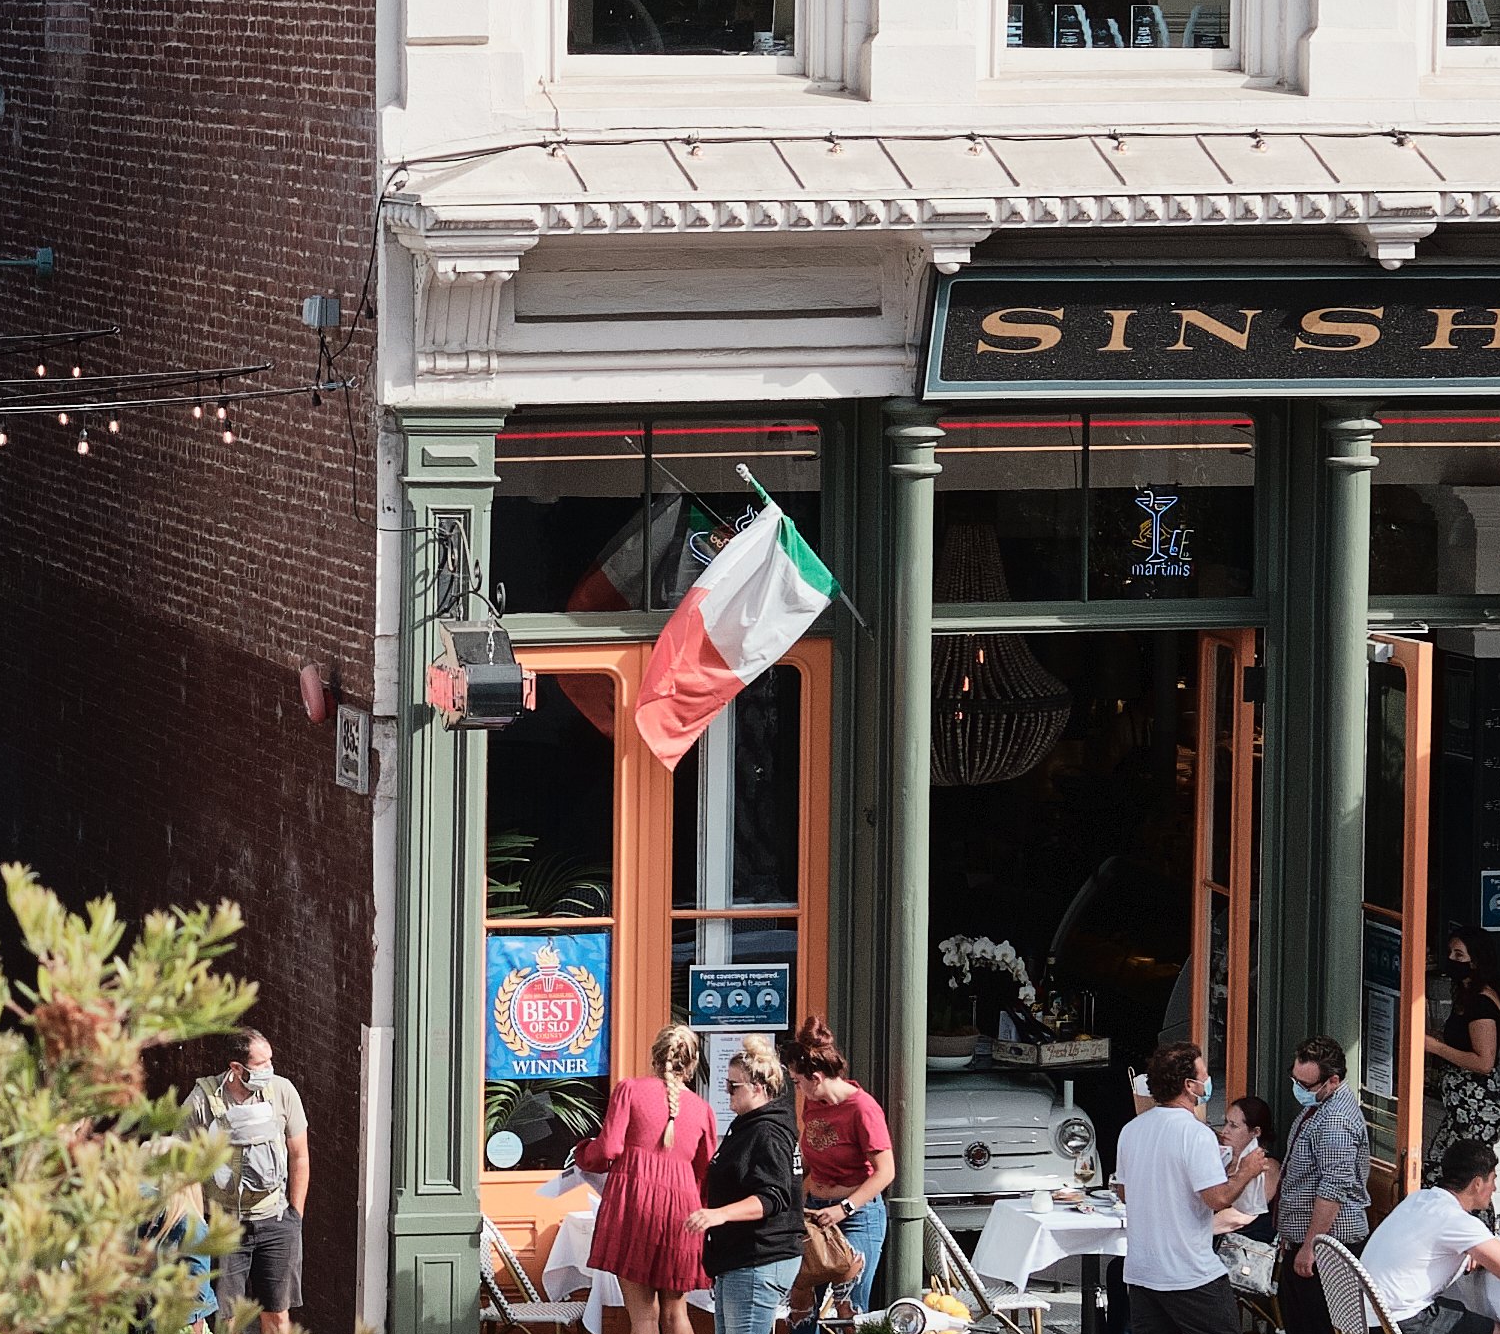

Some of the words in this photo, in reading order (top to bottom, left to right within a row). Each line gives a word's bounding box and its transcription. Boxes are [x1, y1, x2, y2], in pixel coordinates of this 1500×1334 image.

[1131, 561, 1191, 576] martinis
[520, 999, 578, 1022] BEST
[529, 1022, 546, 1033] OF
[547, 1021, 570, 1033] SLO
[512, 1058, 589, 1075] WINNER
